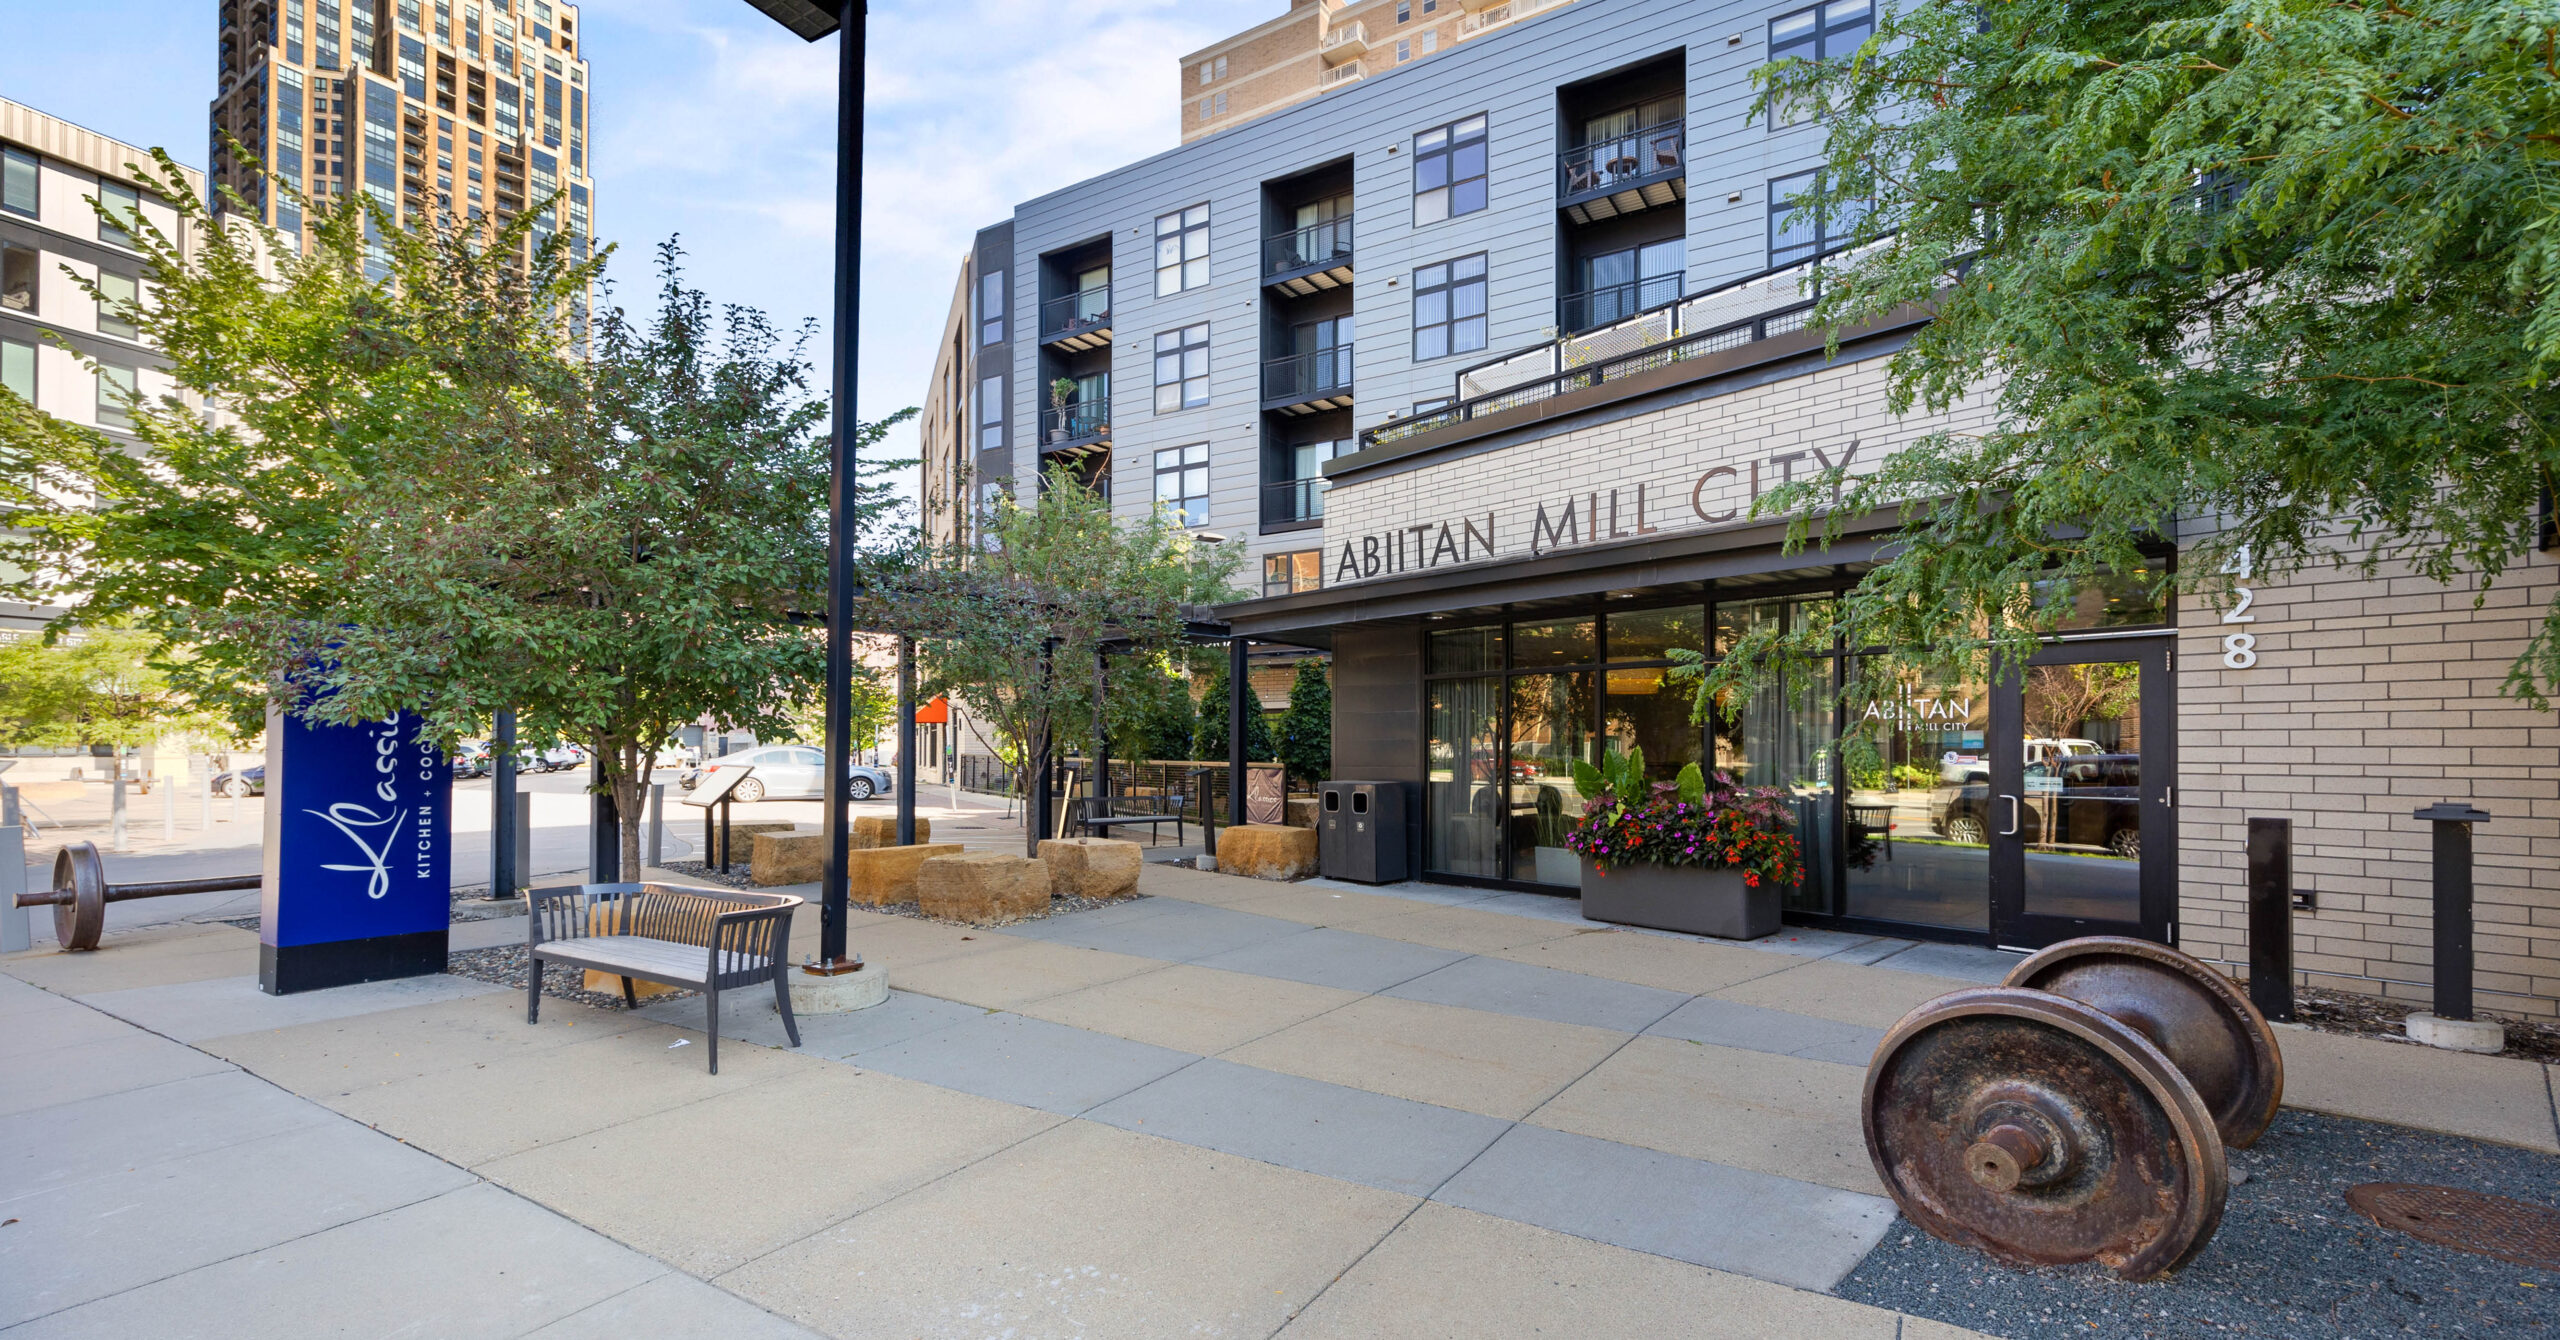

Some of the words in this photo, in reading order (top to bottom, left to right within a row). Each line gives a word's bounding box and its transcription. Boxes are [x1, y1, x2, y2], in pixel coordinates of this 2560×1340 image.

[1336, 512, 1495, 583] ABIITAN
[1531, 483, 1658, 550] MILL
[1692, 440, 1861, 523] CITY
[2220, 543, 2257, 669] 428
[1942, 722, 1969, 732] CITY
[417, 806, 432, 878] KITCHEN
